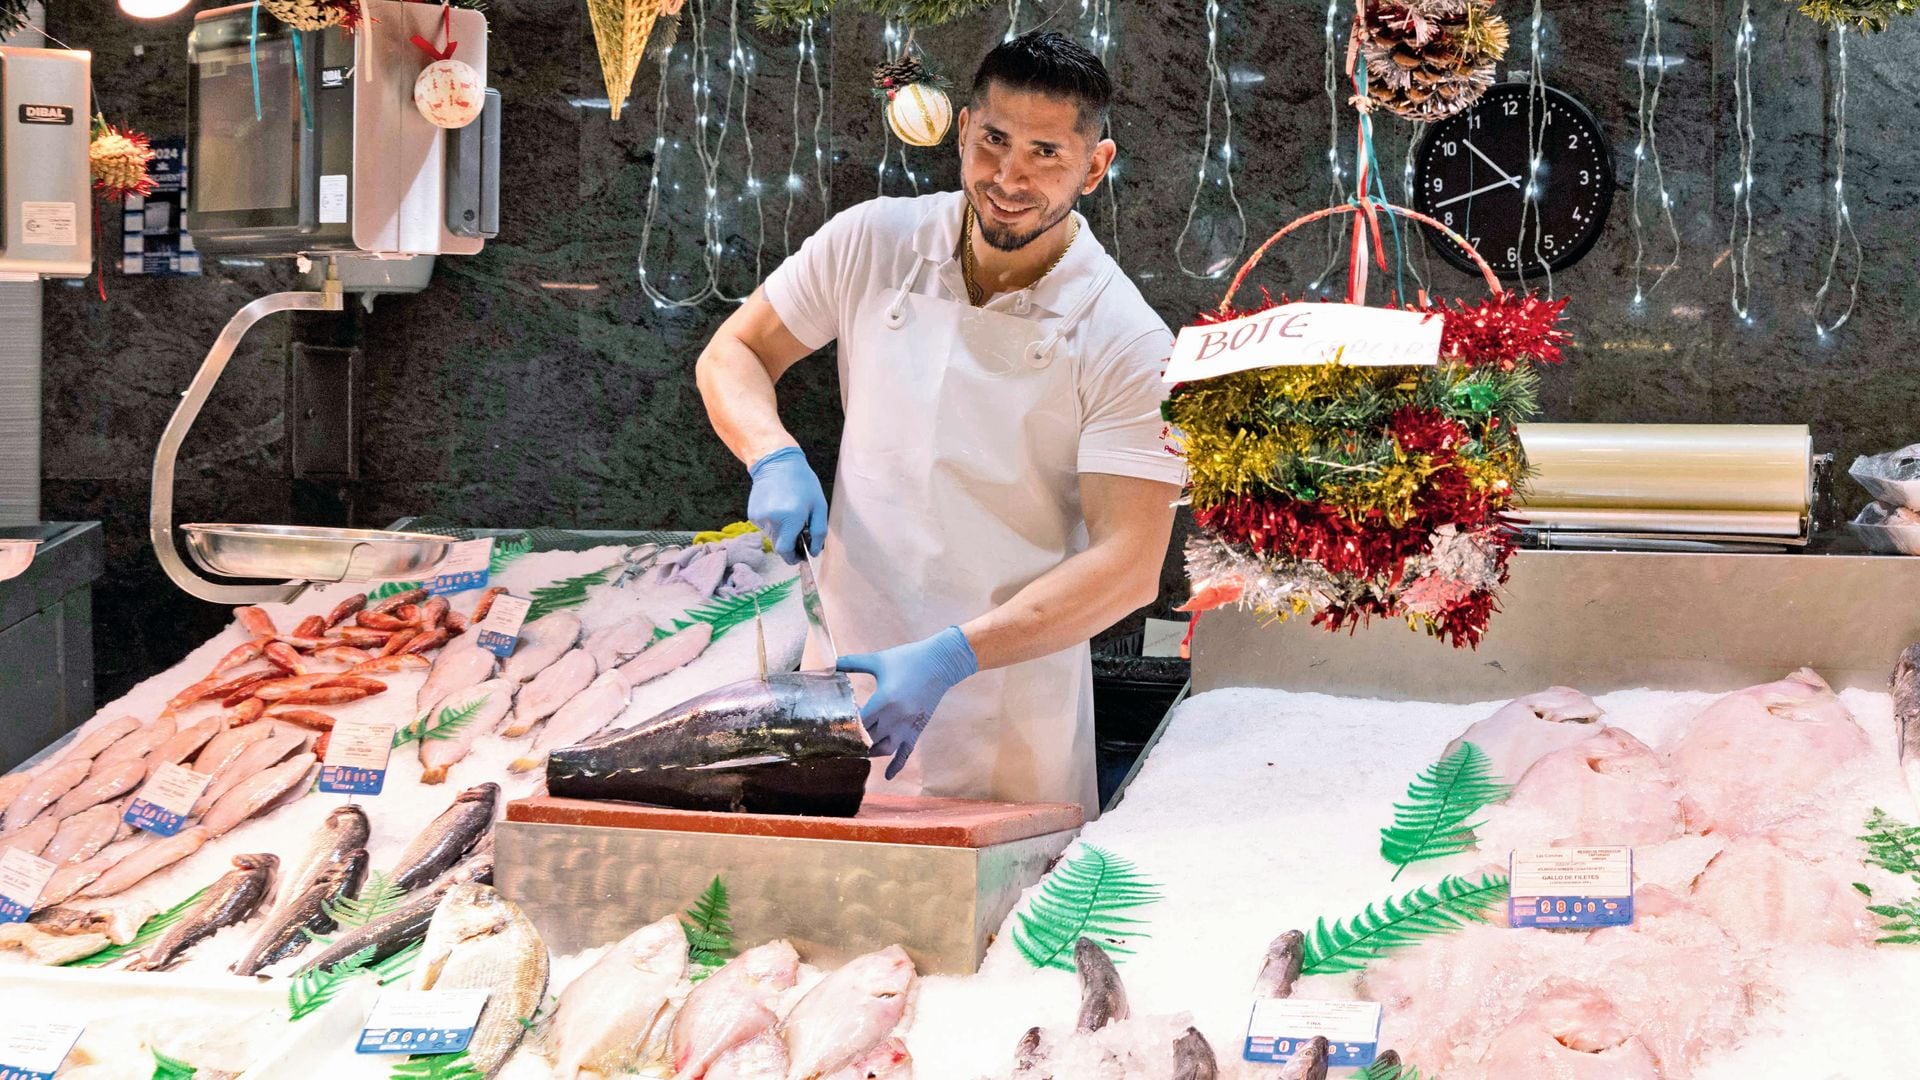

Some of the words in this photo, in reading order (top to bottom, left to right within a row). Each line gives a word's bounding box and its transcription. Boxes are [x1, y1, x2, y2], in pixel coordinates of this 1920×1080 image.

[26, 106, 66, 118] DIBAL
[1502, 101, 1518, 116] 12
[1467, 114, 1481, 129] 11
[1545, 110, 1552, 125] 1
[1441, 141, 1457, 156] 10
[1568, 134, 1578, 149] 2
[154, 148, 178, 160] 024
[1433, 178, 1443, 192] 9
[1579, 170, 1589, 185] 3
[1444, 211, 1453, 226] 8
[1572, 206, 1582, 221] 4
[1471, 237, 1481, 250] 7
[1543, 235, 1554, 250] 5
[1507, 247, 1517, 262] 6
[1195, 311, 1312, 361] BOTE
